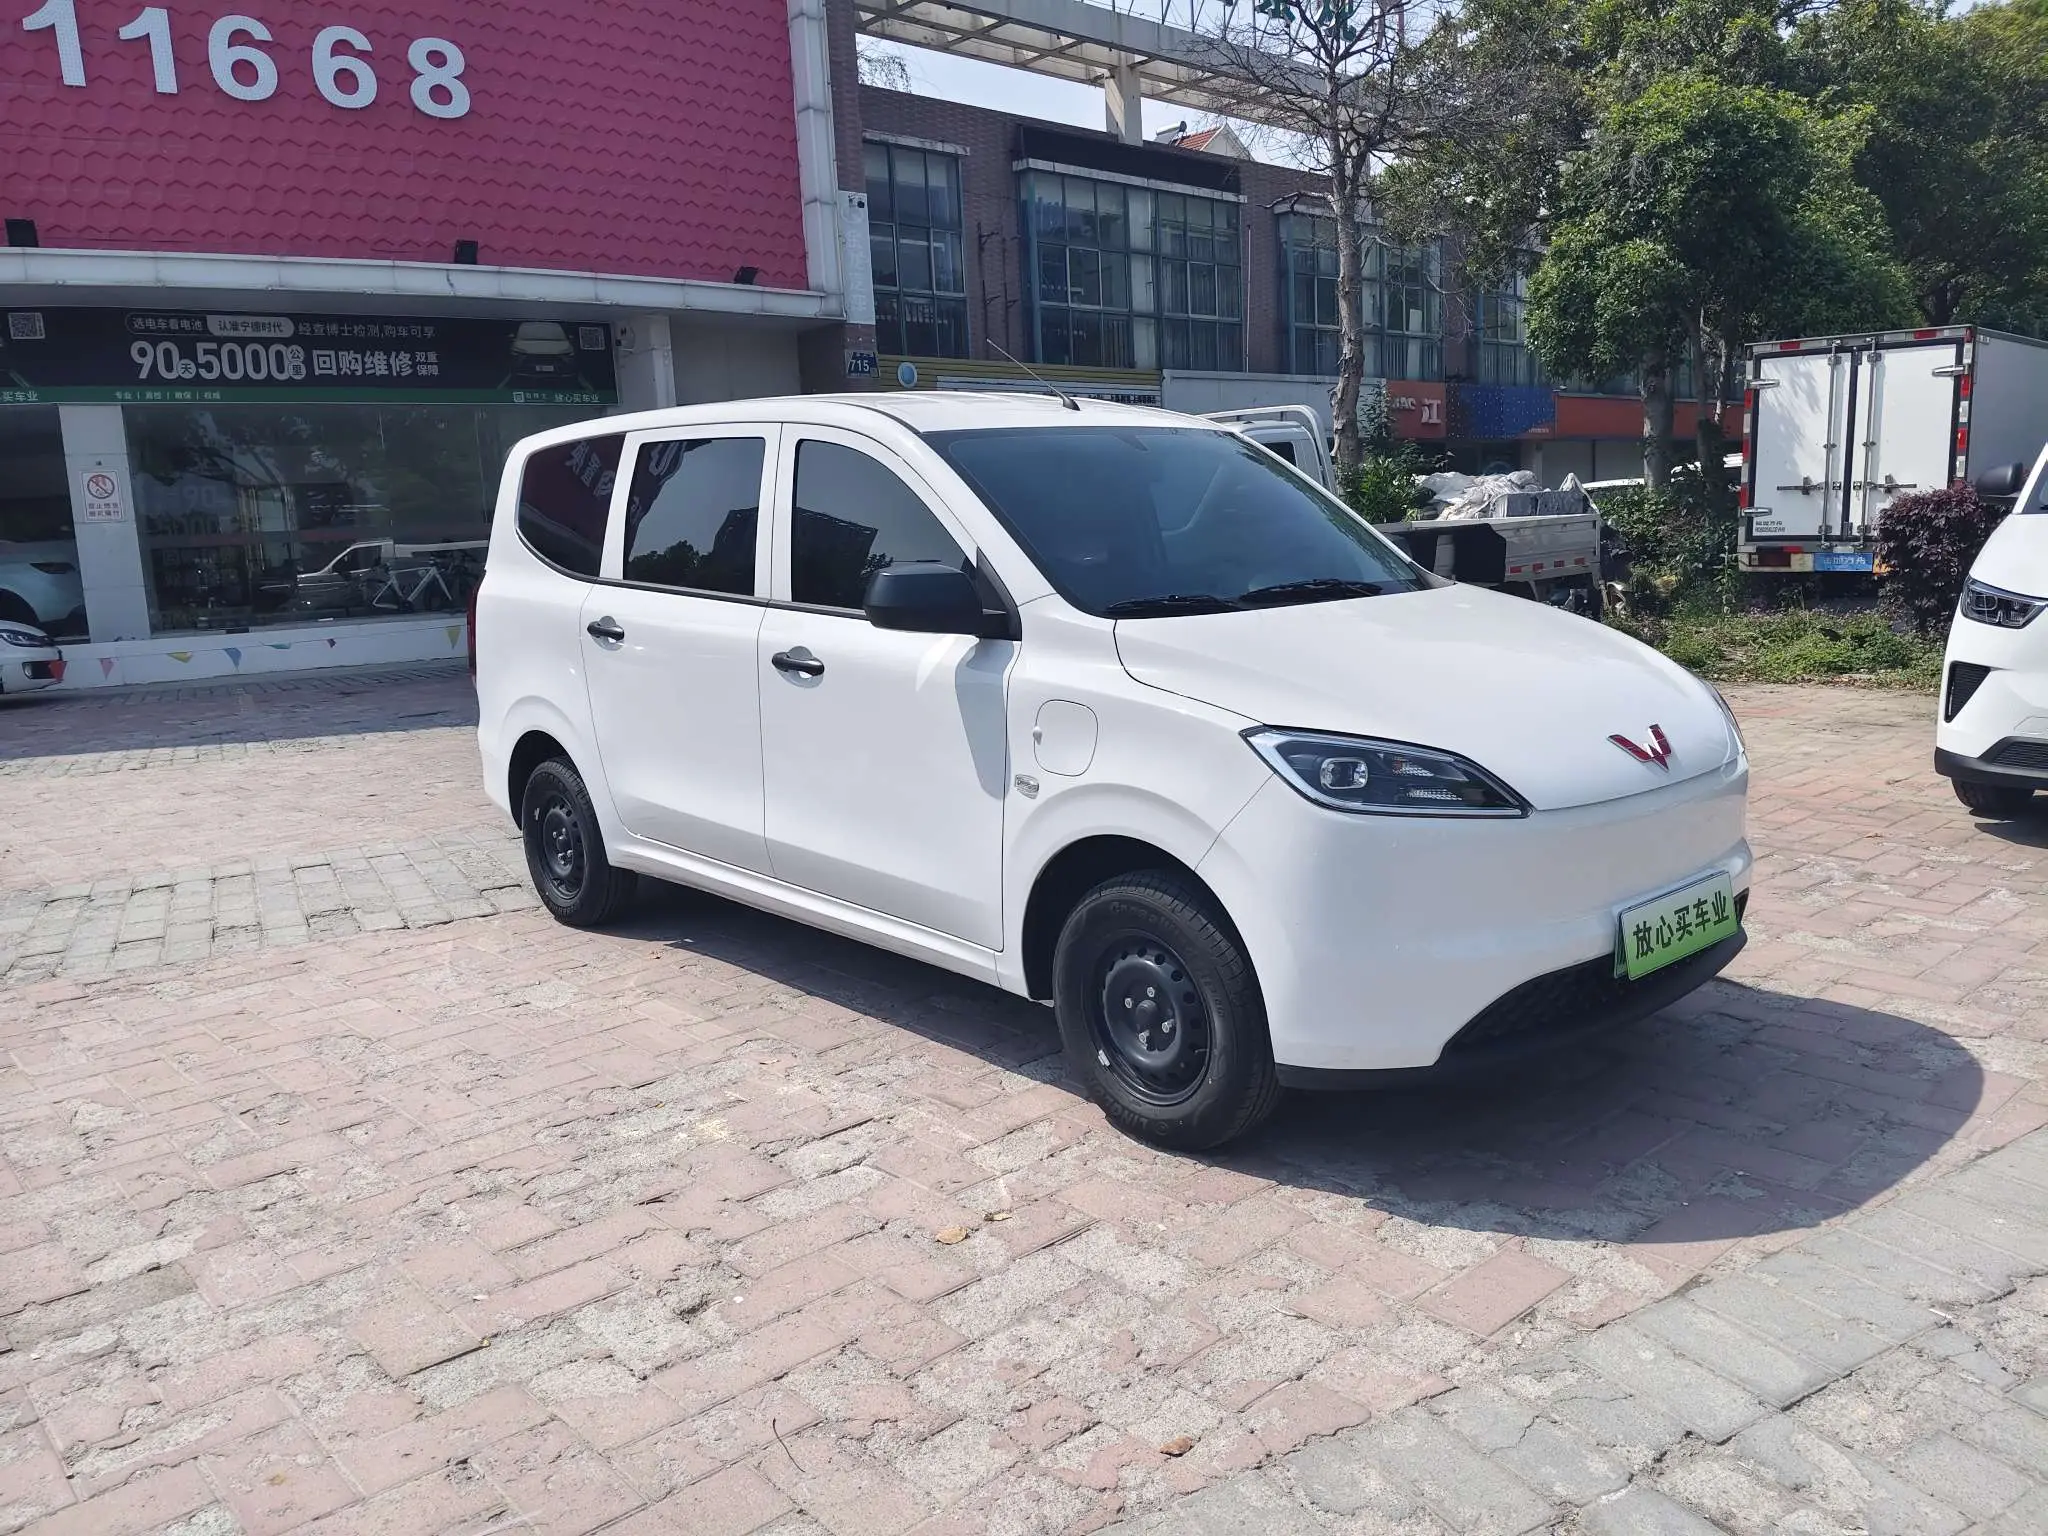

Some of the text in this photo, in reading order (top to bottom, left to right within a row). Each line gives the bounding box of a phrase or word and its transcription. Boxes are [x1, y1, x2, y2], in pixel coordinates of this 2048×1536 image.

[22, 0, 471, 119] 11668
[132, 317, 203, 331] 选电车看电池
[217, 319, 285, 333] 认准宁德时代
[312, 350, 414, 377] 回购维修
[415, 352, 438, 363] 双重
[417, 364, 439, 376] 保障
[849, 359, 870, 372] 715
[0, 390, 39, 402] 买车业
[1632, 890, 1730, 960] 放心买车业
